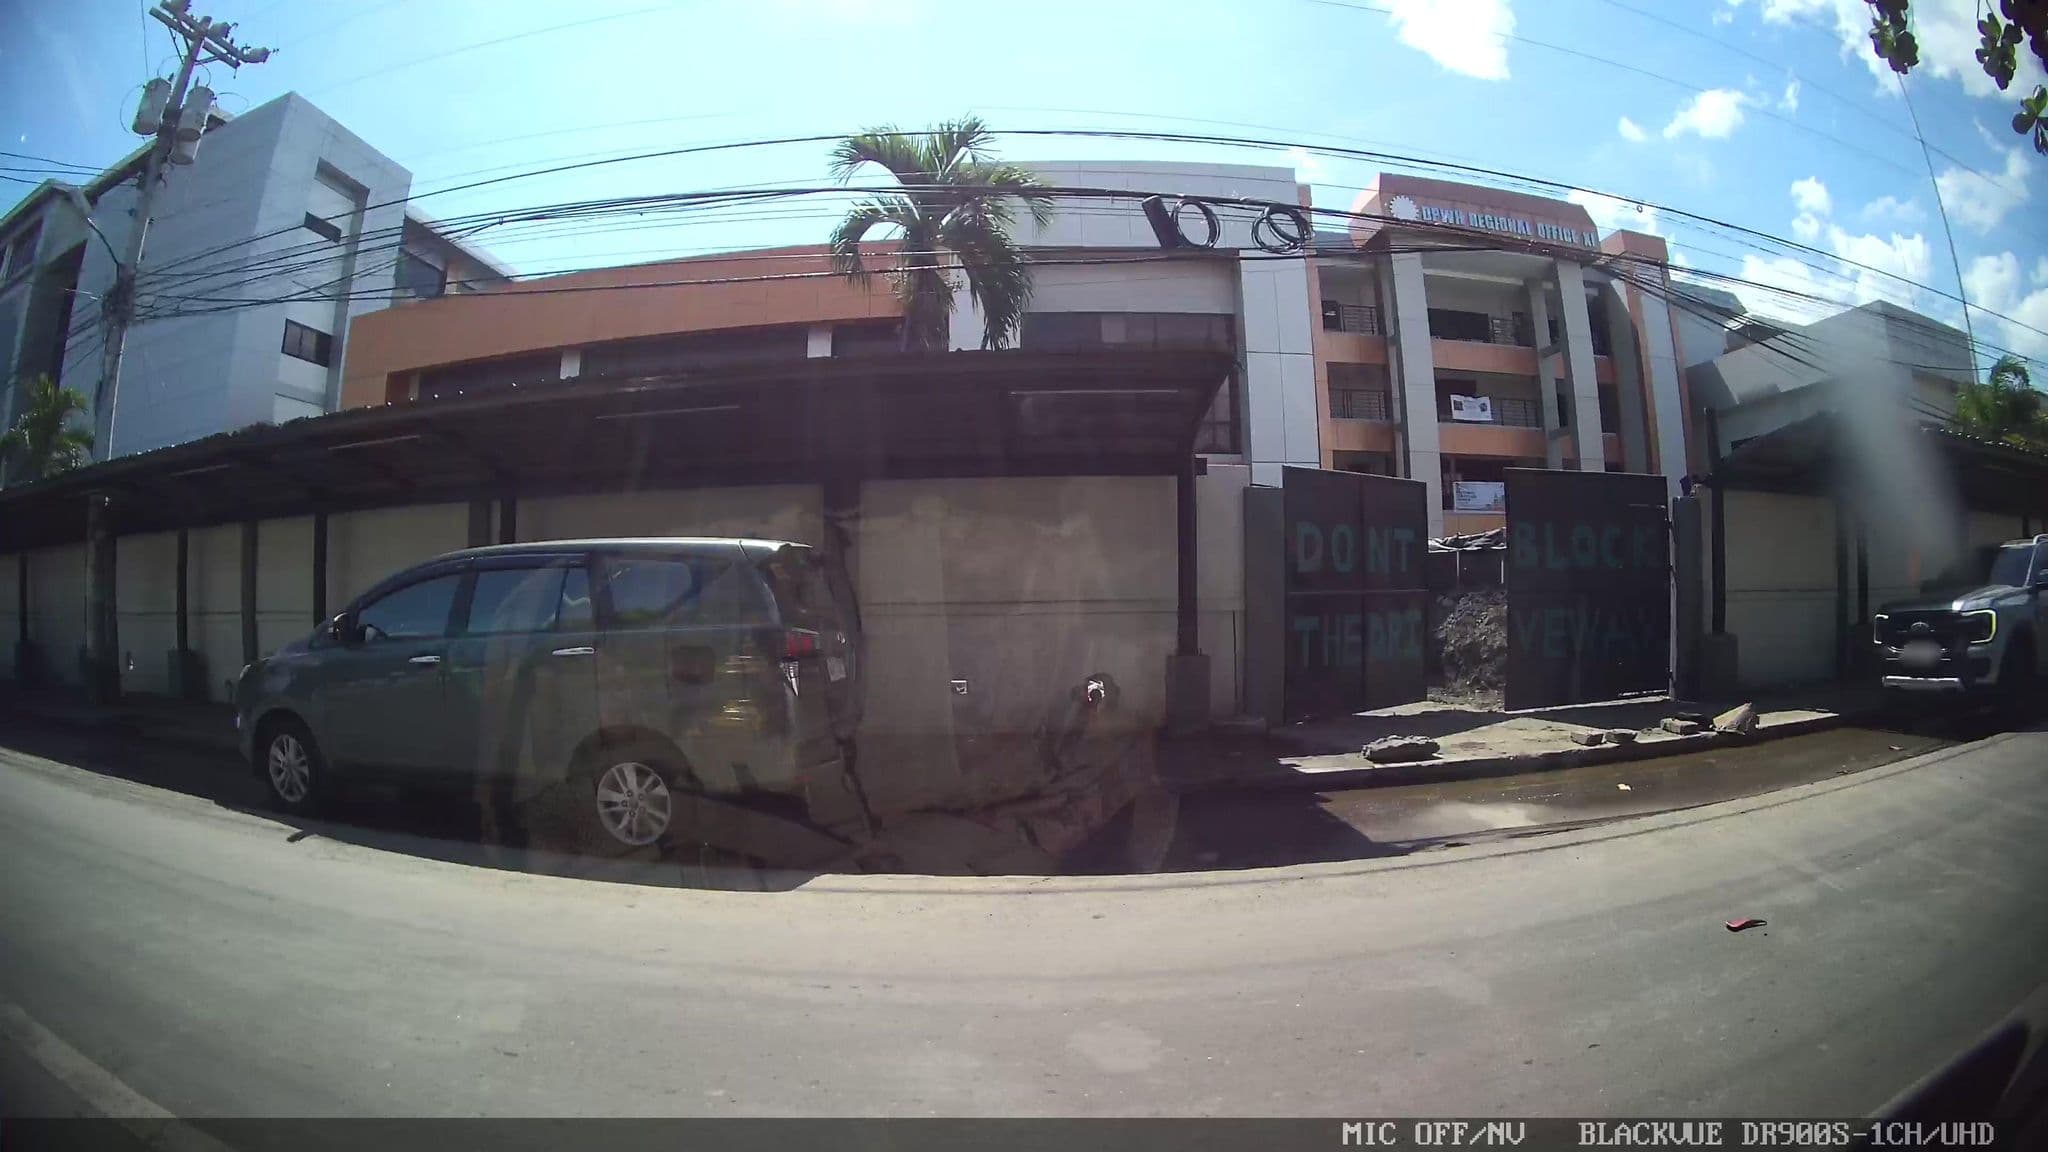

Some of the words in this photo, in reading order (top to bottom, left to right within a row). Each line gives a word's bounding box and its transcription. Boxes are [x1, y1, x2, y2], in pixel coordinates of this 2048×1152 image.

[1422, 206, 1462, 225] DPWH
[1469, 212, 1533, 236] REGIONAL
[1537, 223, 1577, 244] OFFICE
[1296, 521, 1415, 574] DONT
[1514, 521, 1664, 569] BLOCK
